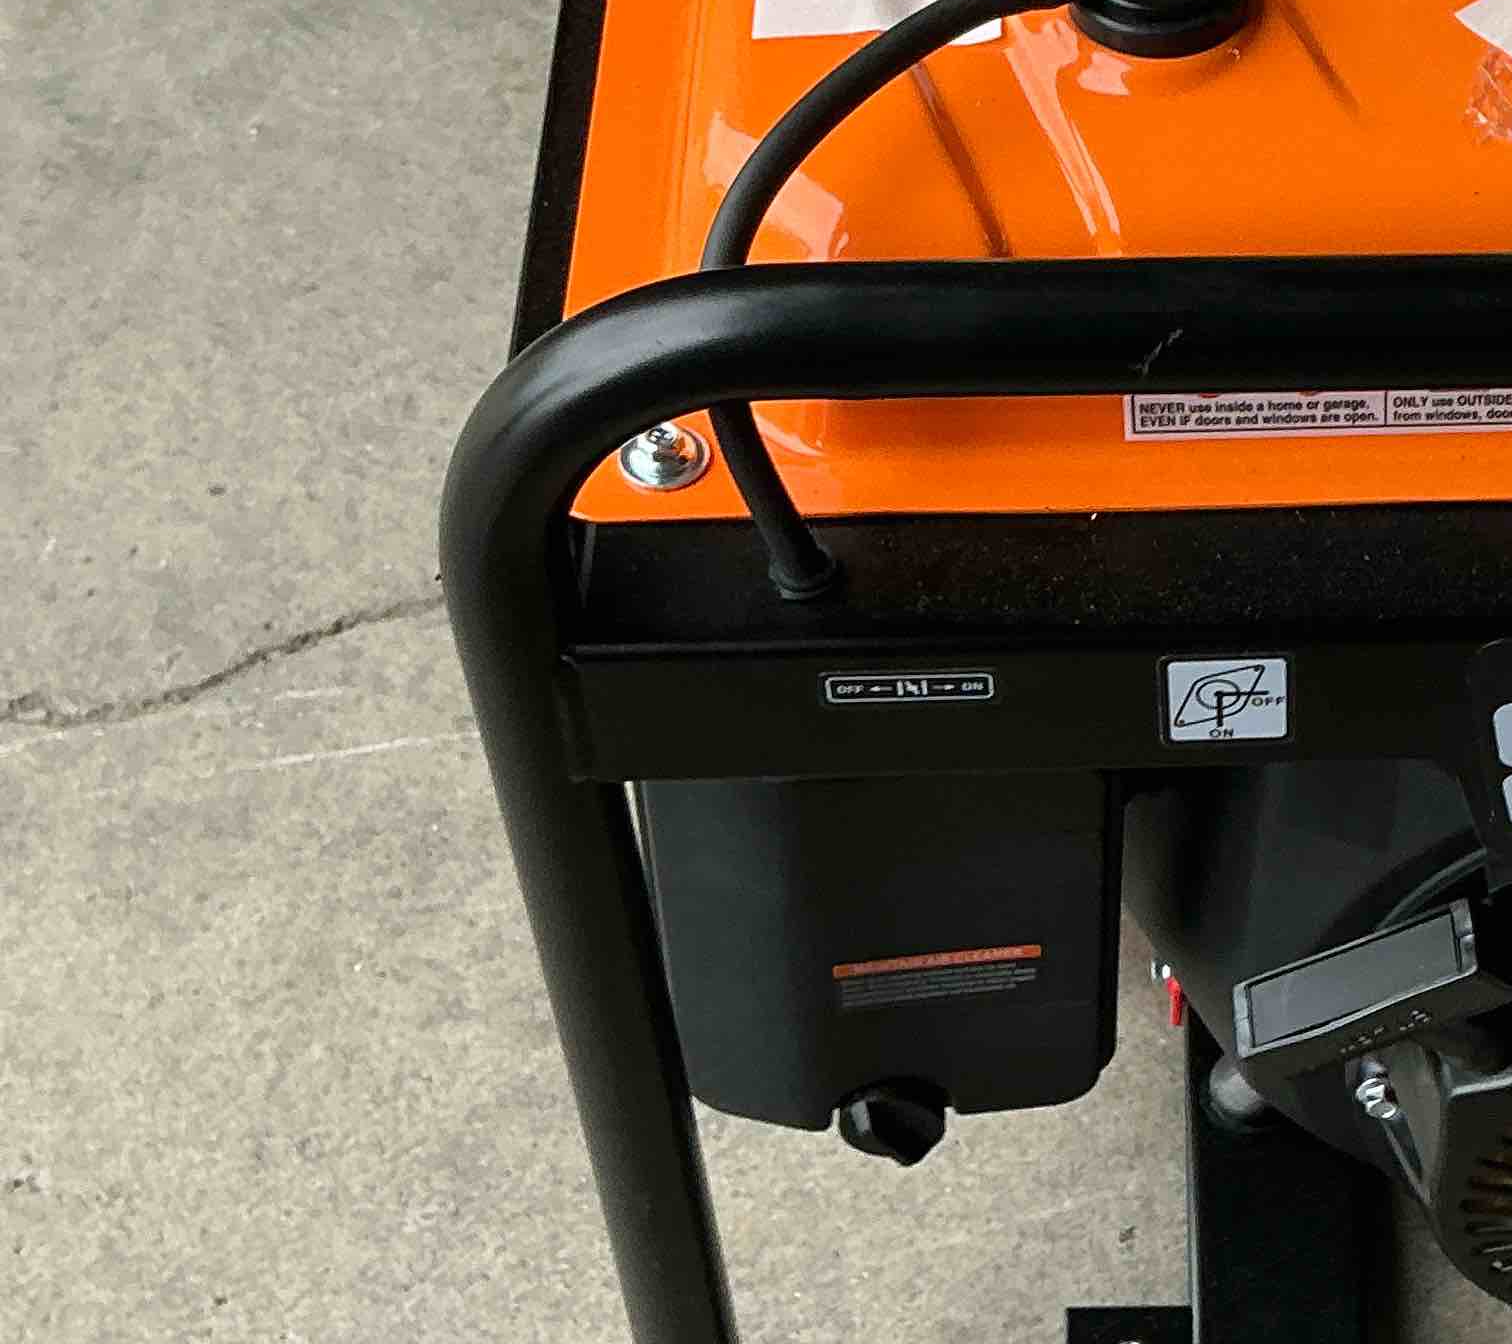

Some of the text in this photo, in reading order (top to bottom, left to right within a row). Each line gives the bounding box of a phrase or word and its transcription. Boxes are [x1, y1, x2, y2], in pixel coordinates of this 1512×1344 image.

[1139, 402, 1185, 414] NEVER
[1189, 404, 1212, 413] use
[1215, 400, 1252, 412] inside
[1268, 400, 1302, 411] home
[1307, 401, 1320, 410] or
[1393, 396, 1428, 408] ONLY
[1431, 398, 1454, 407] use
[1457, 394, 1511, 406] OUTSIDE
[1140, 415, 1176, 427] EVEN
[1180, 415, 1190, 426] IF
[1198, 414, 1231, 425] doors
[1235, 413, 1258, 424] and
[1262, 412, 1317, 424] windows
[1320, 414, 1340, 423] are
[1393, 410, 1421, 422] from
[836, 684, 865, 695] OFF
[1251, 696, 1286, 707] OFF
[1209, 728, 1235, 739] ON
